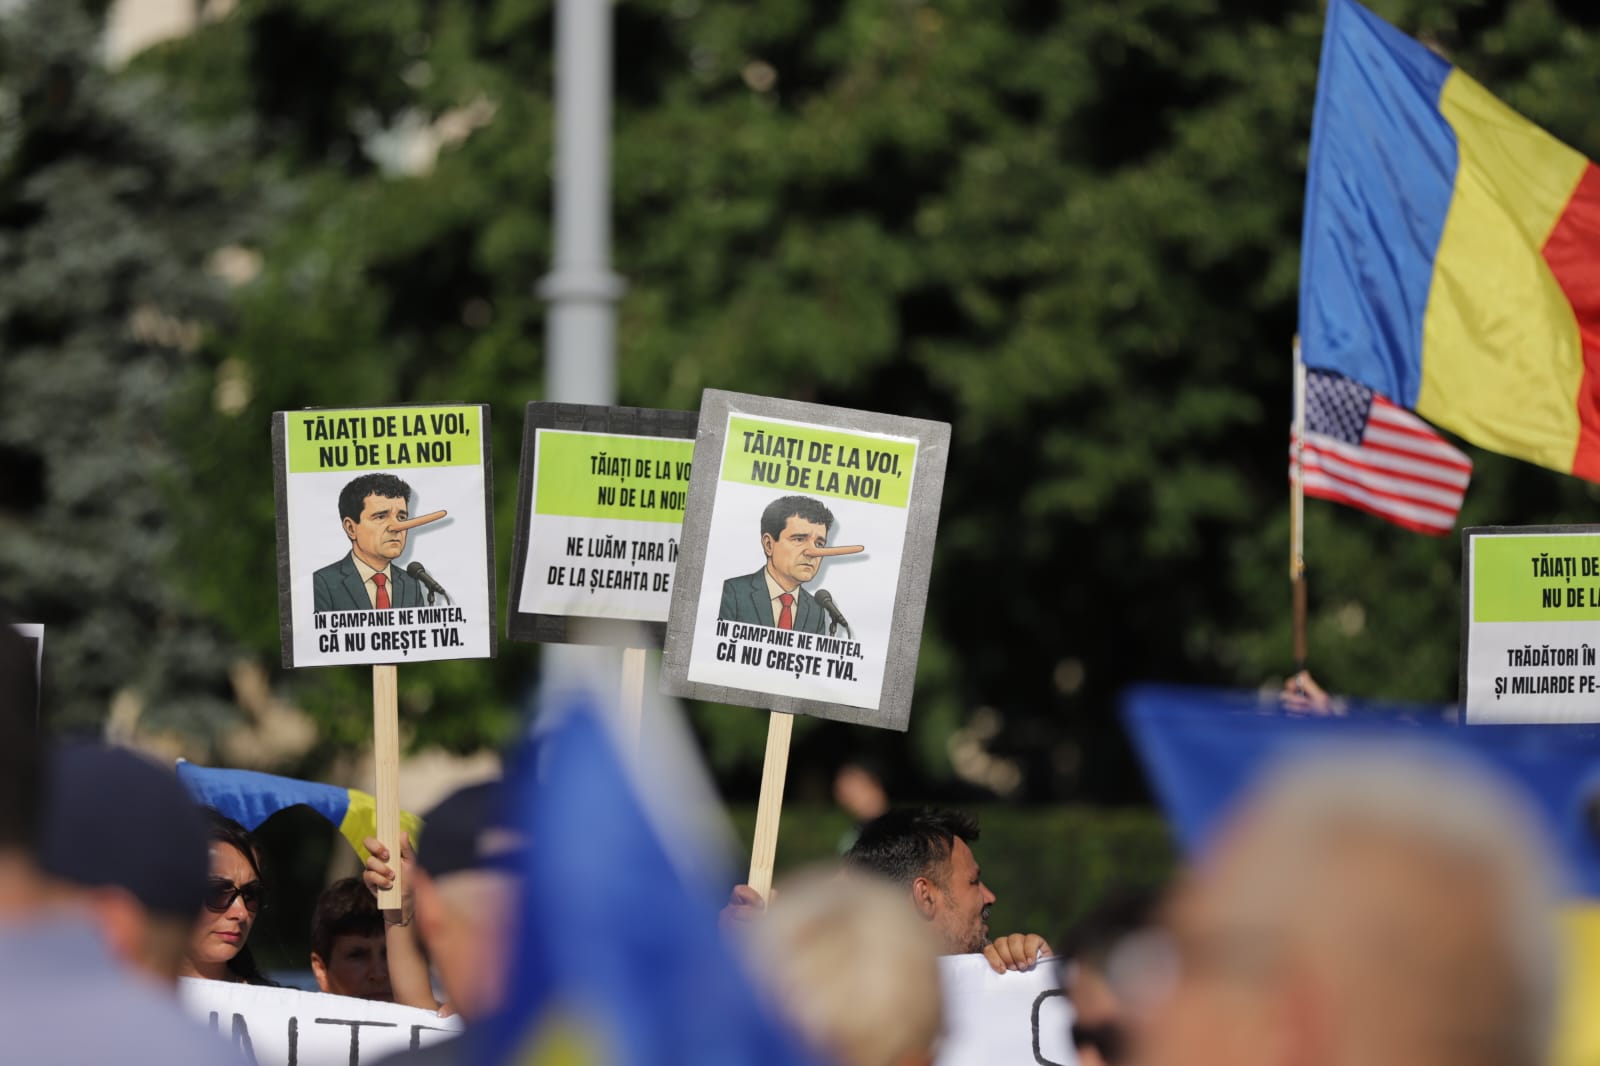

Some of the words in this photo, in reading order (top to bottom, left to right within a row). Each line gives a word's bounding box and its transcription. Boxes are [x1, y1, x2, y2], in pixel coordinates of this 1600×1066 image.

[373, 416, 396, 437] DE
[402, 414, 427, 435] LA
[431, 412, 470, 437] VOI,
[320, 446, 348, 468] NU
[355, 444, 379, 466] DE
[387, 443, 411, 465] LA
[417, 441, 451, 463] NOI
[591, 452, 631, 483] TĂIAȚI
[635, 458, 652, 478] DE
[656, 460, 670, 480] LA
[676, 462, 692, 481] VO
[808, 441, 833, 465] DE
[837, 446, 861, 468] LA
[866, 451, 902, 478] VOI,
[751, 460, 781, 484] NU
[785, 465, 811, 488] DE
[816, 471, 839, 493] LA
[845, 475, 881, 499] NOI
[598, 486, 616, 506] NU
[620, 488, 636, 507] DE
[640, 490, 655, 509] LA
[660, 491, 686, 511] NOI!
[567, 537, 584, 556] NE
[588, 535, 626, 559] LUĂM
[632, 541, 664, 566] ȚARA
[547, 566, 565, 586] DE
[570, 568, 585, 587] LA
[590, 569, 648, 593] ȘLEAHTA
[653, 572, 669, 592] DE
[1532, 553, 1576, 583] TĂIAȚI
[1581, 557, 1600, 577] DE
[1542, 588, 1562, 608] NU
[1567, 587, 1585, 608] DE
[1590, 587, 1600, 607] L
[313, 610, 327, 629] ÎN
[331, 611, 395, 628] CAMPANIE
[399, 610, 413, 625] NE
[418, 607, 467, 627] MINȚEA,
[319, 629, 340, 653] CĂ
[345, 633, 366, 652] NU
[371, 630, 427, 656] CREȘTE
[431, 628, 464, 647] TVA.
[716, 617, 729, 637] ÎN
[732, 623, 794, 648] CAMPANIE
[797, 634, 813, 650] NE
[816, 637, 864, 660] MINȚEA,
[716, 639, 738, 663] CĂ
[741, 645, 763, 667] NU
[766, 649, 822, 679] CREȘTE
[827, 658, 858, 682] TVA.
[1507, 645, 1578, 667] TRĂDĂTORI
[1581, 643, 1596, 666] ÎN
[1495, 676, 1507, 700] ȘI
[1512, 675, 1575, 694] MILIARDE
